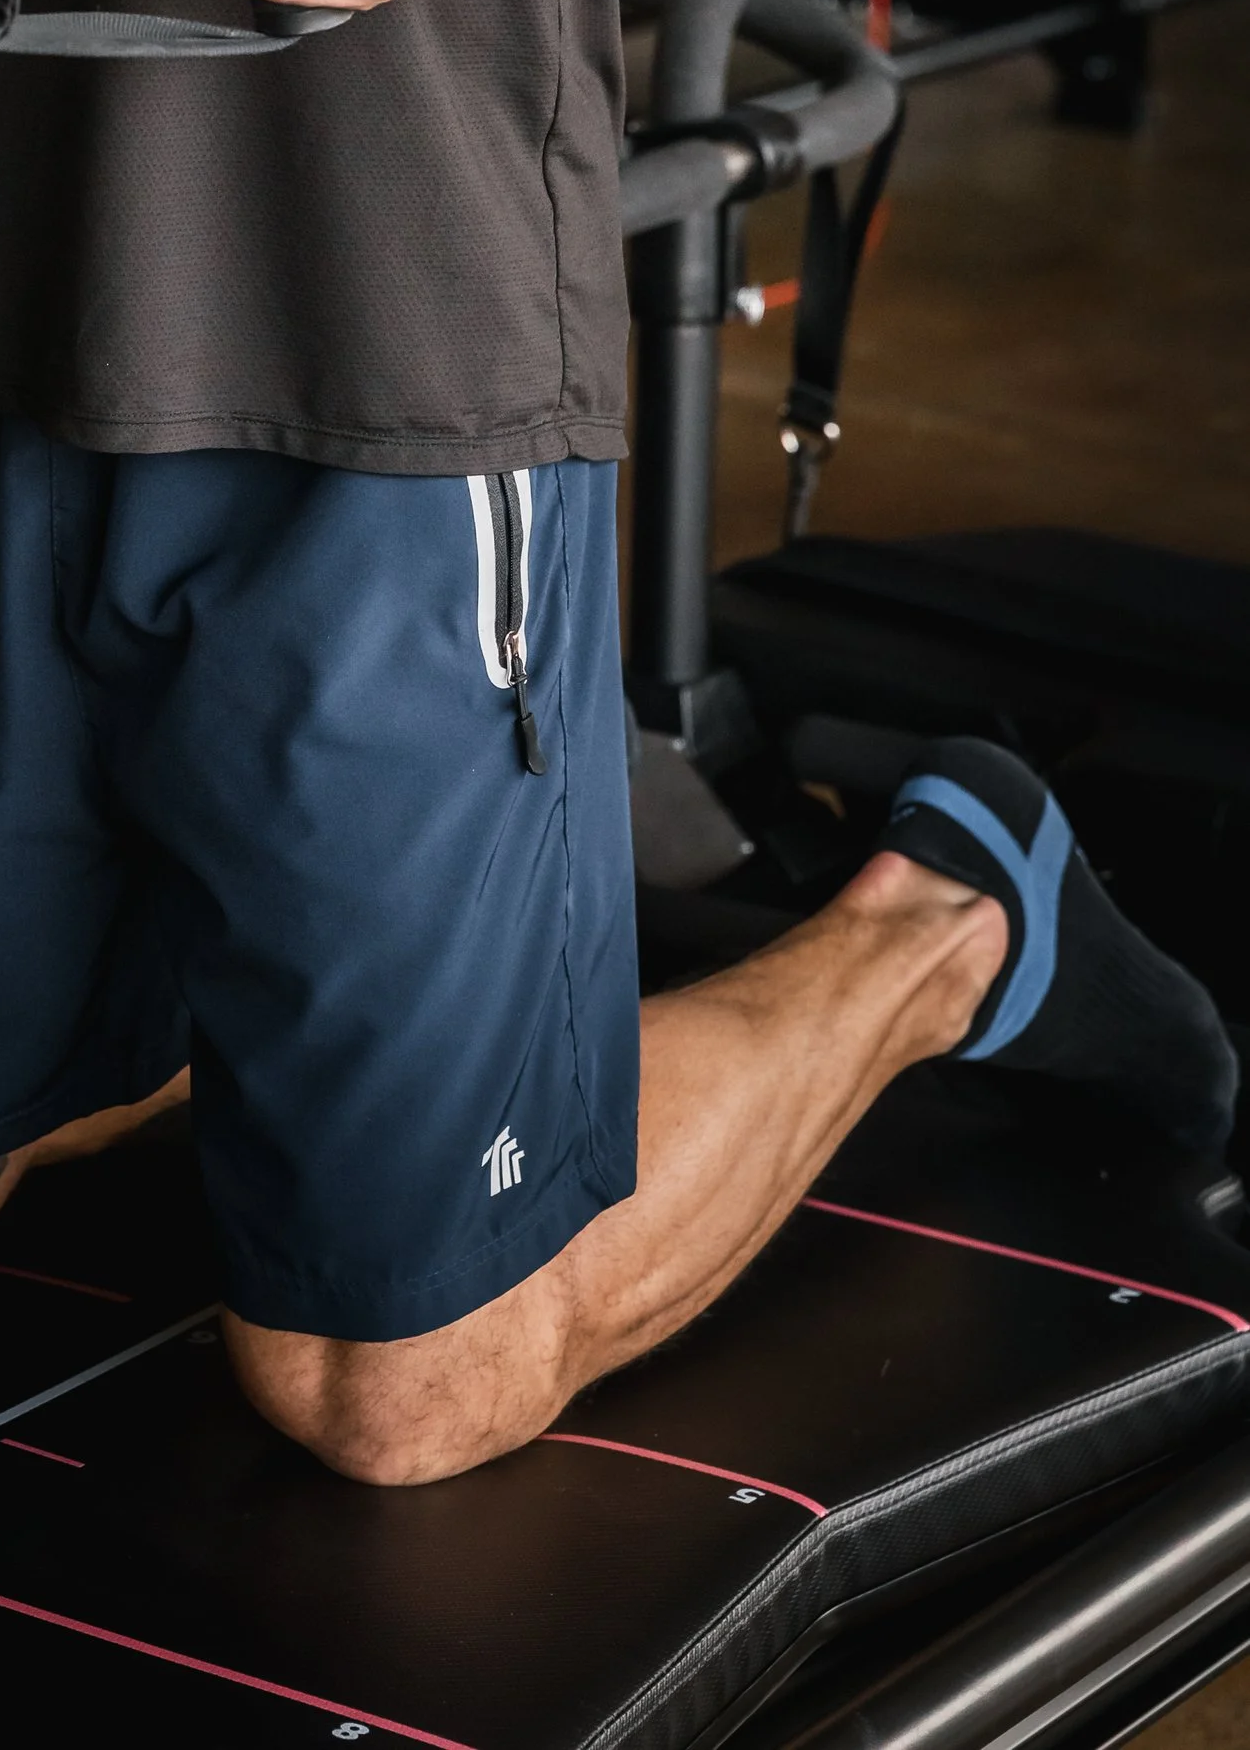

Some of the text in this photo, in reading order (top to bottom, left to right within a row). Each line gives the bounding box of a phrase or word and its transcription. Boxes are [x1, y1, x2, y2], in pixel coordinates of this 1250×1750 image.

[1109, 1286, 1142, 1304] 2
[728, 1488, 766, 1504] 5
[331, 1722, 370, 1740] 8
